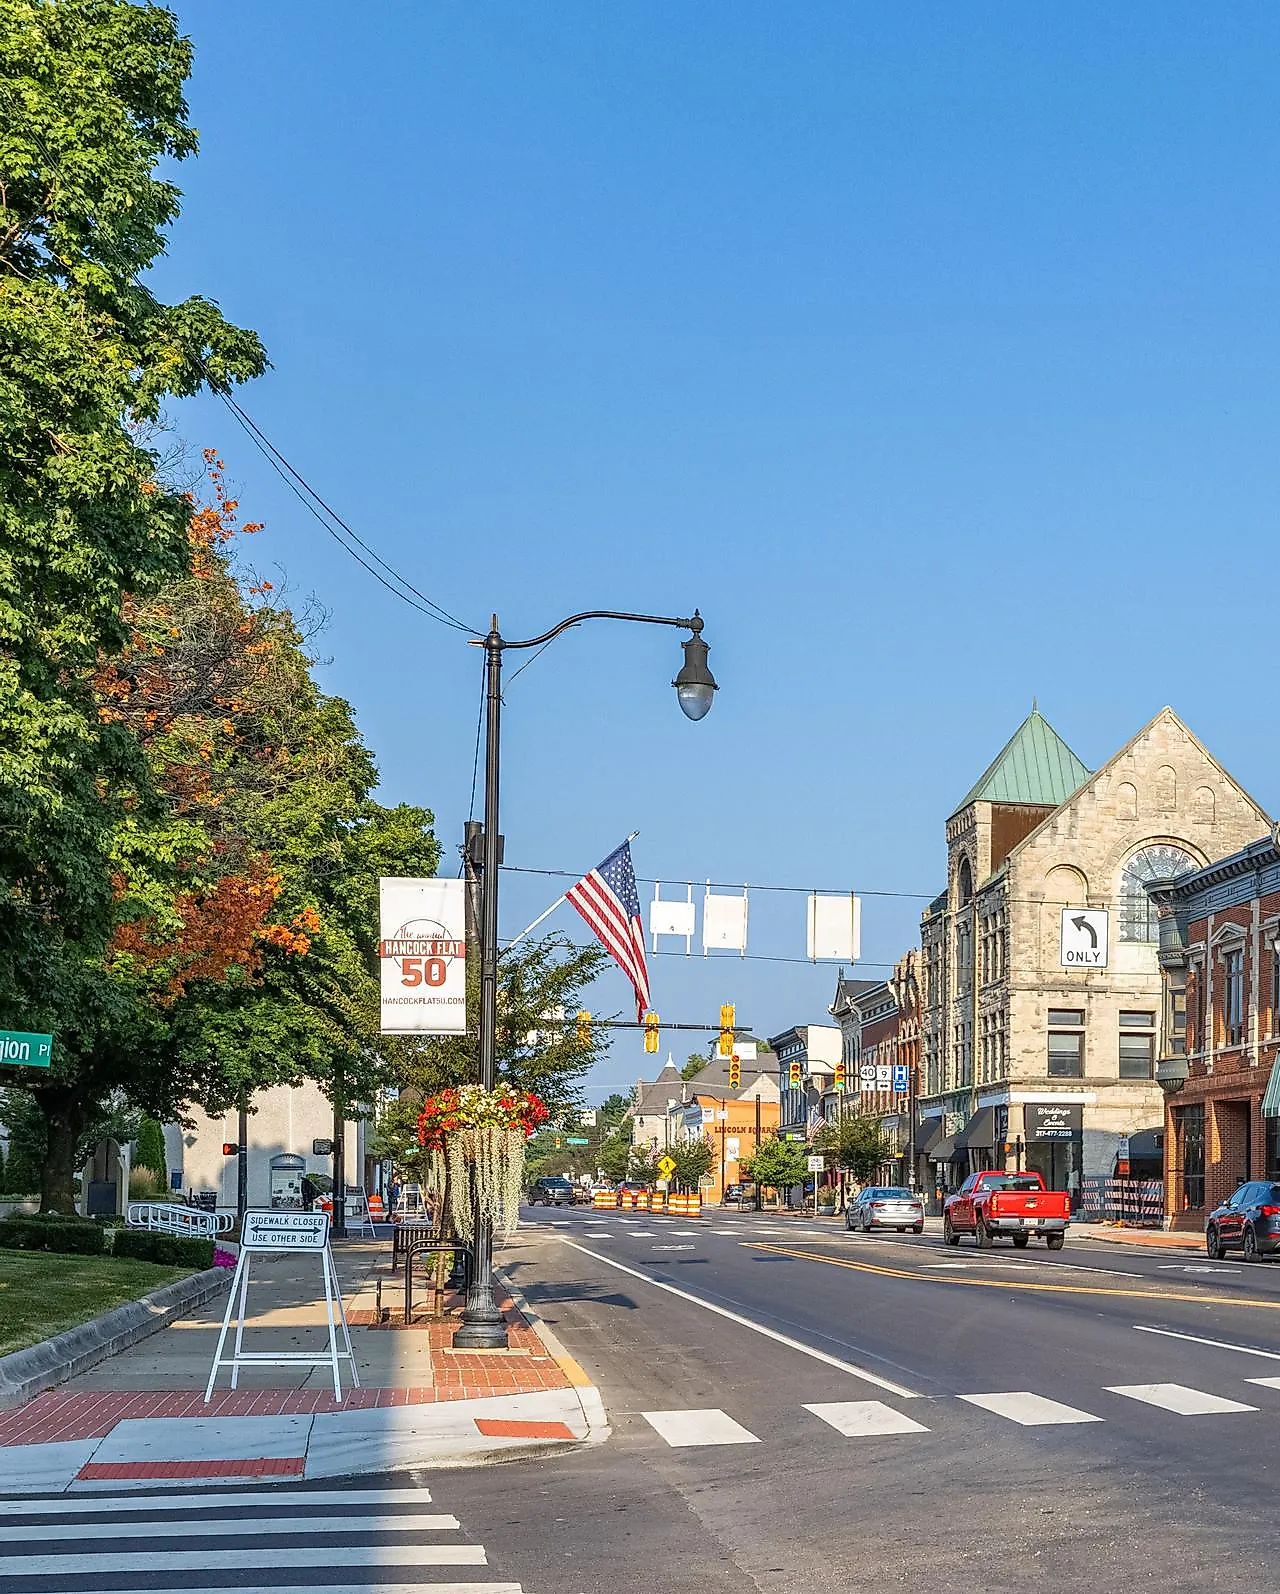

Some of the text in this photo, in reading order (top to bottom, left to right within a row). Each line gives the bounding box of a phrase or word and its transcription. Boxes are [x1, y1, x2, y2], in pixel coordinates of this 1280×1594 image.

[385, 941, 461, 955] HANCOCK FLAT
[1066, 950, 1101, 963] ONLY
[401, 957, 447, 987] 50
[861, 1068, 874, 1077] 40
[881, 1070, 888, 1079] 9
[1036, 1106, 1072, 1117] Weddings
[250, 1216, 324, 1227] SIDEWALK CLOSED
[252, 1234, 318, 1244] USE OTHER SIDE
